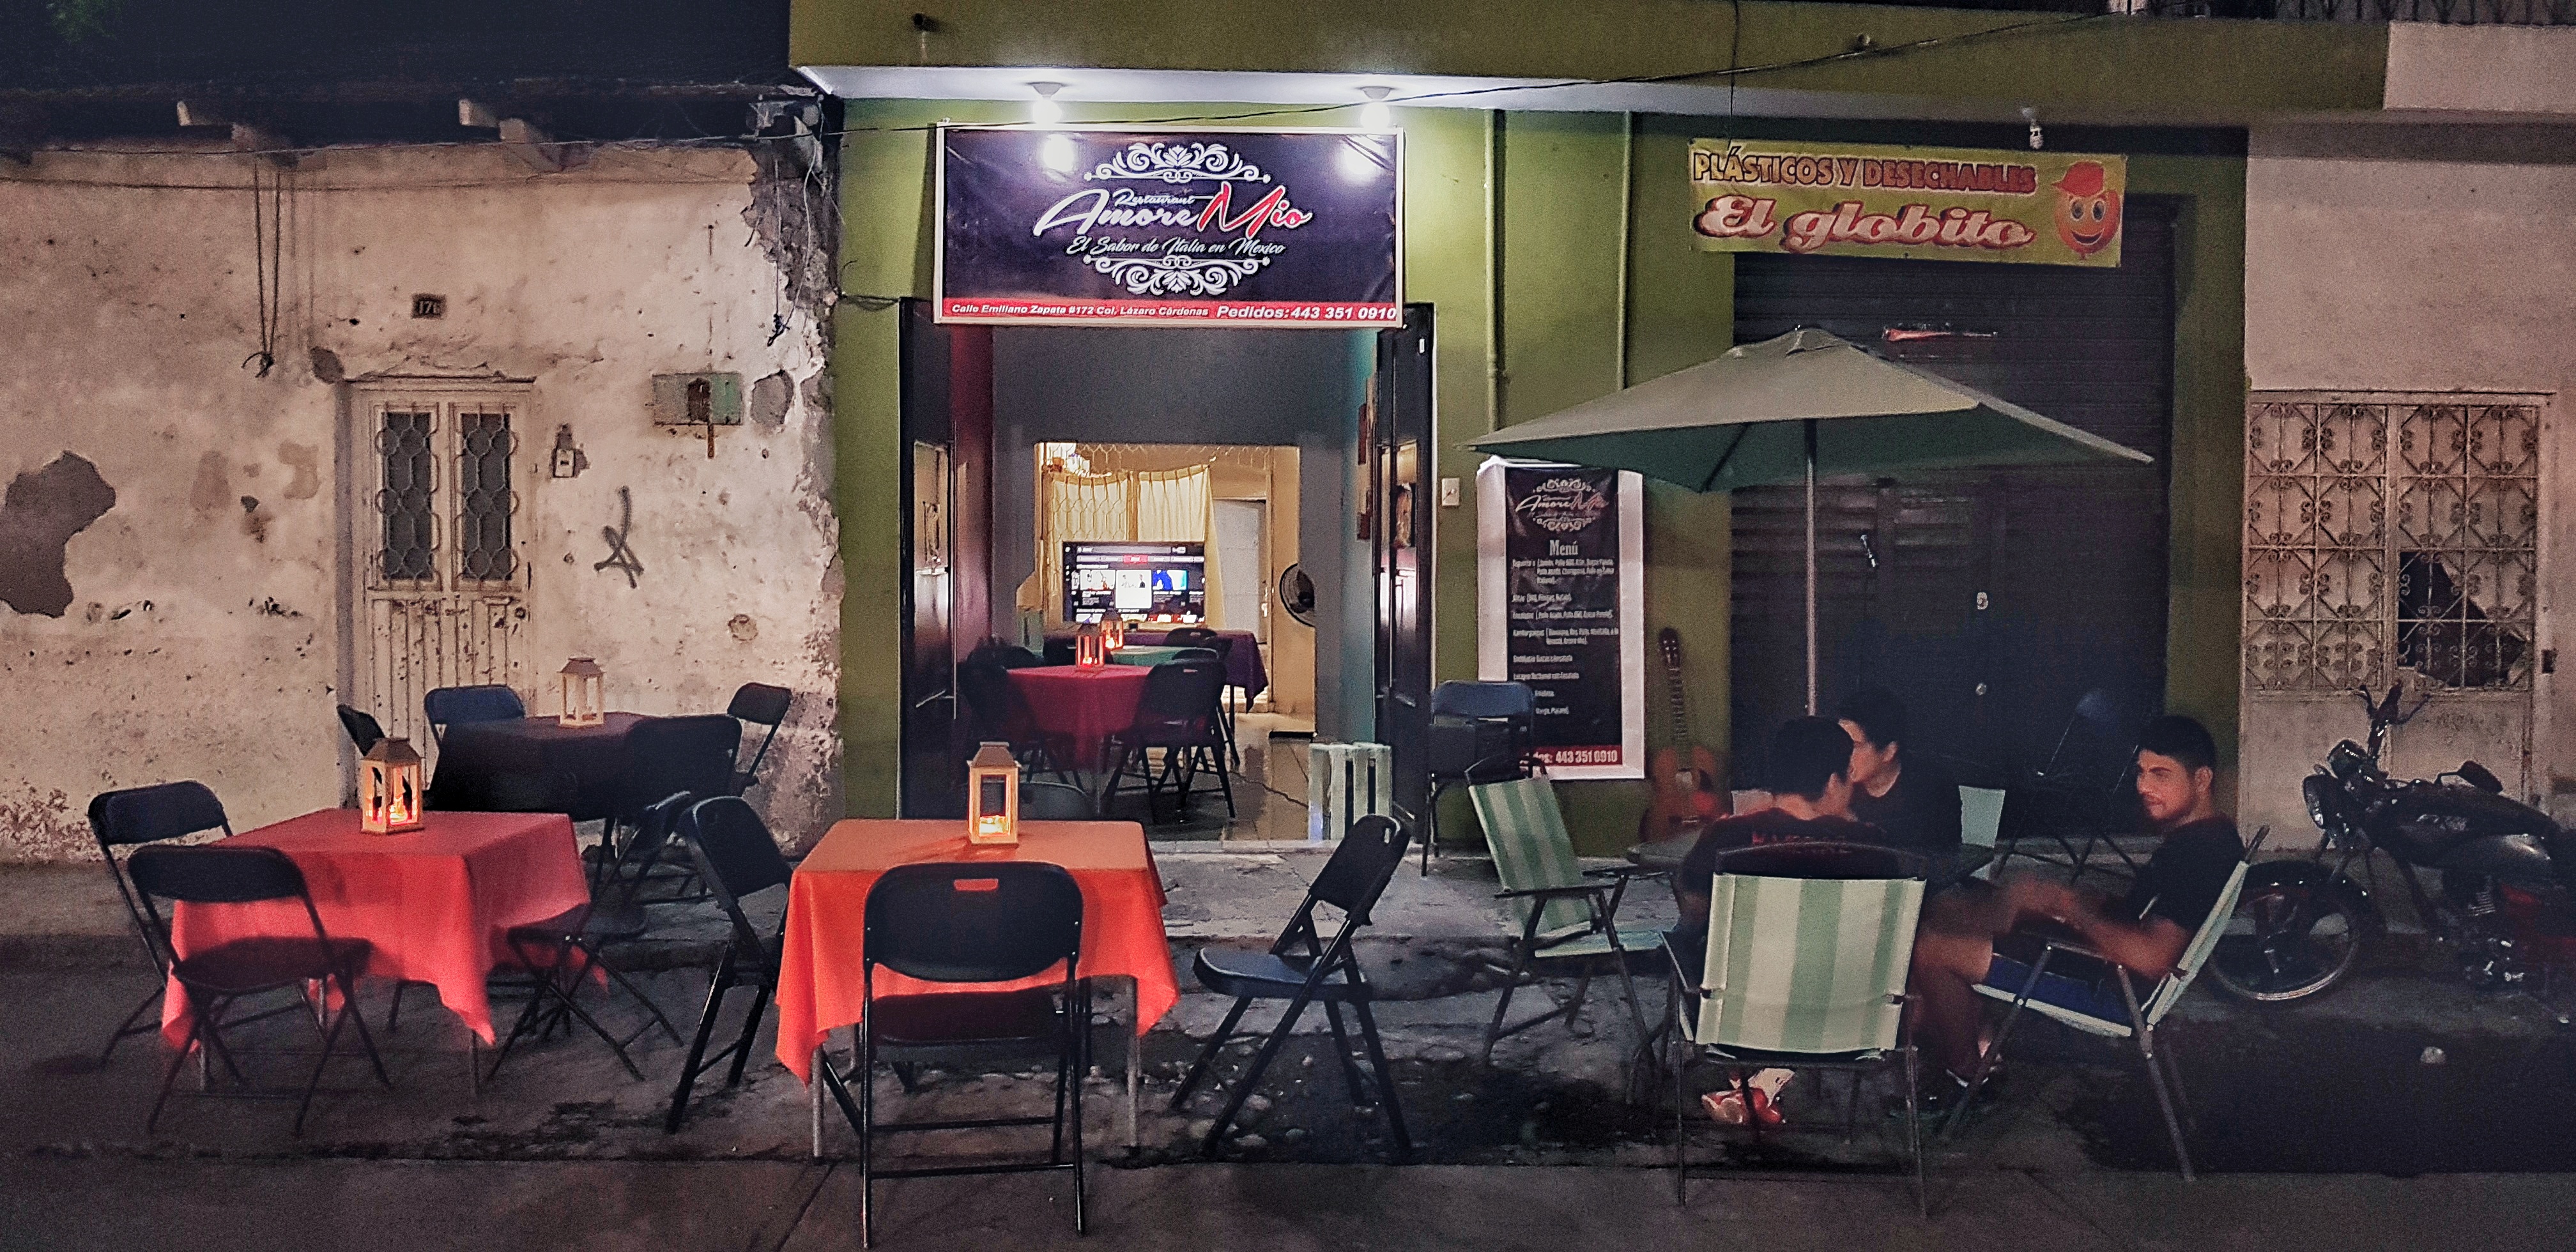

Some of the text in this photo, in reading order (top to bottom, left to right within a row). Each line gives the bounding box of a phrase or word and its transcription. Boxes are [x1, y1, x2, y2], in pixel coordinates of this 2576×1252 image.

[1693, 146, 2036, 194] PLÁSTICOS Y DESECHABLES
[1113, 188, 1195, 206] Restaurant
[1032, 181, 1313, 239] Amore Mio
[1695, 194, 2037, 253] El globito
[1066, 235, 1087, 255] El
[1090, 237, 1140, 256] Sabor
[1141, 238, 1159, 254] de
[1161, 235, 1207, 256] Italia
[1208, 241, 1225, 254] en
[952, 303, 979, 313] Calle
[981, 303, 1028, 314] Emiliano
[1030, 305, 1066, 315] Zapata
[1068, 305, 1094, 314] #172
[1120, 306, 1156, 316] Lázaro
[1158, 307, 1209, 316] Cárdenas
[1324, 307, 1353, 319] 351
[1358, 307, 1397, 319] 0910
[1515, 494, 1570, 512] Amore
[1549, 540, 1579, 556] Menú
[1555, 751, 1574, 763] 443
[1575, 750, 1593, 763] 351
[1593, 749, 1618, 763] 0910
